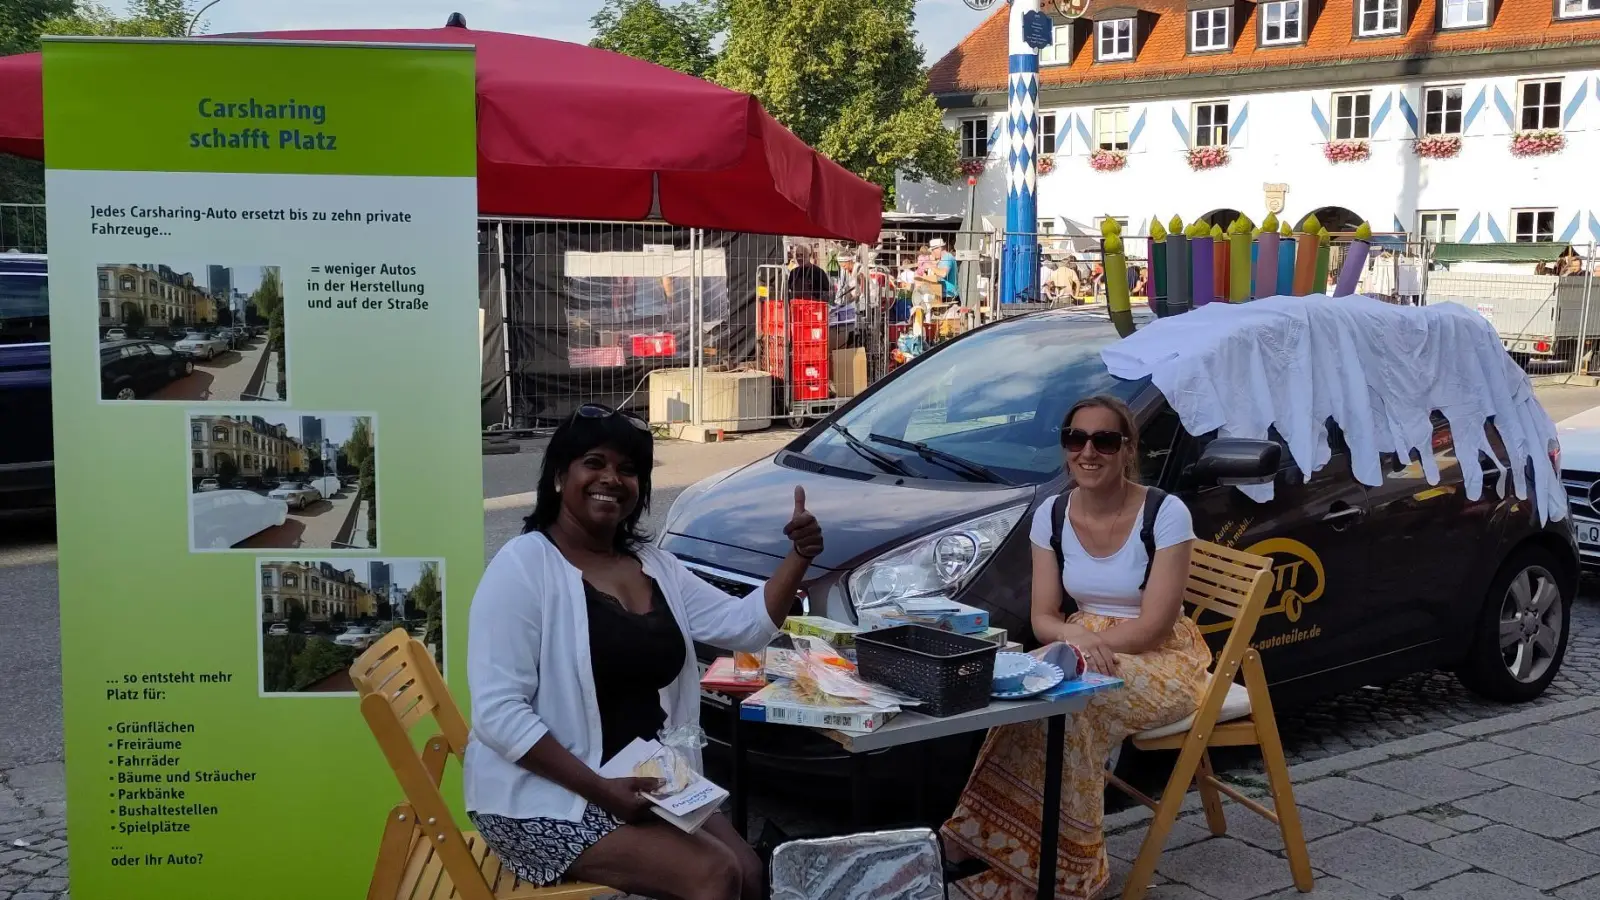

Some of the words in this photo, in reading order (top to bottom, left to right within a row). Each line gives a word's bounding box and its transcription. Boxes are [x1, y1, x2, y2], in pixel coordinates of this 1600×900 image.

[198, 97, 326, 125] Carsharing
[189, 128, 270, 149] schafft
[278, 129, 338, 151] Platz
[90, 205, 126, 219] Jedes
[130, 205, 238, 222] Carsharing-Auto
[241, 208, 286, 221] ersetzt
[289, 208, 308, 221] bis
[311, 211, 327, 221] zu
[331, 209, 362, 222] zehn
[365, 210, 412, 225] private
[91, 223, 172, 239] Fahrzeuge...
[324, 264, 376, 278] weniger
[379, 264, 417, 276] Autos
[307, 279, 320, 292] in
[323, 279, 346, 292] der
[349, 280, 425, 296] Herstellung
[307, 297, 333, 310] und
[336, 297, 358, 310] auf
[361, 297, 384, 310] der
[386, 297, 430, 311] Straße
[123, 673, 138, 684] so
[141, 671, 196, 685] entsteht
[199, 670, 233, 684] mehr
[106, 688, 140, 701] Platz
[142, 688, 166, 701] für:
[116, 721, 195, 735] Grünflächen
[116, 737, 183, 751] Freiräume
[116, 754, 181, 768] Fahrräder
[117, 770, 163, 785] Bäume
[166, 770, 191, 784] und
[194, 769, 258, 783] Sträucher
[117, 786, 186, 801] Parkbänke
[118, 803, 219, 817] Bushaltestellen
[118, 820, 191, 835] Spielplätze
[110, 854, 141, 867] oder
[144, 853, 165, 866] Ihr
[166, 852, 204, 866] Auto?
